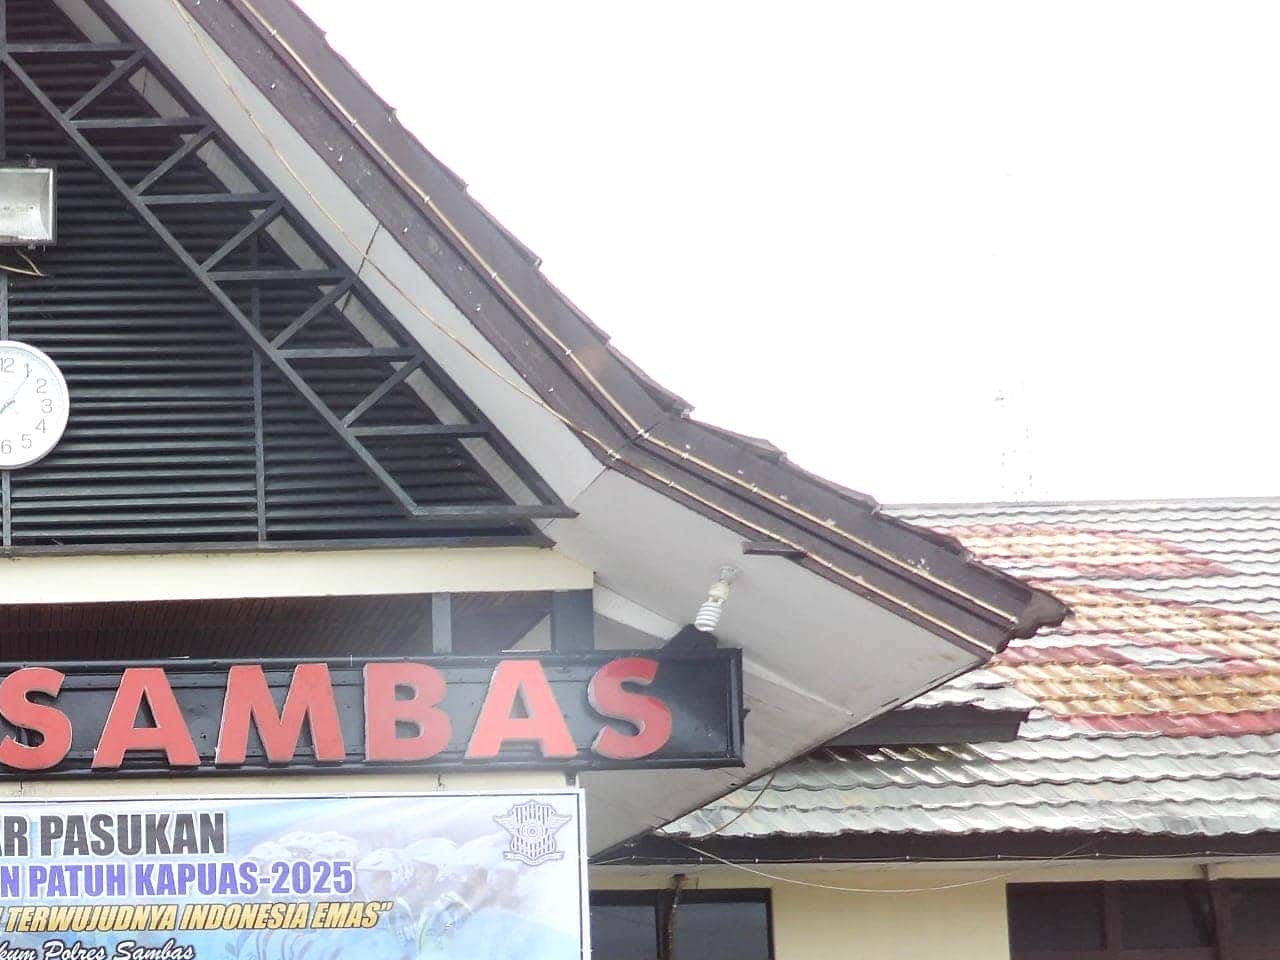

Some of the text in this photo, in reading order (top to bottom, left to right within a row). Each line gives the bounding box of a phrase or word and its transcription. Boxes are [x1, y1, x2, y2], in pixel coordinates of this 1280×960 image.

[36, 378, 47, 394] 2
[41, 398, 52, 414] 3
[35, 418, 48, 433] 4
[1, 439, 12, 454] 6
[21, 434, 32, 449] 5
[40, 813, 225, 857] PASUKAN
[29, 863, 126, 897] PATUH
[135, 861, 353, 895] KAPUAS-2025
[5, 904, 179, 933] TERWUJUDNYA
[179, 902, 311, 931] INDONESIA
